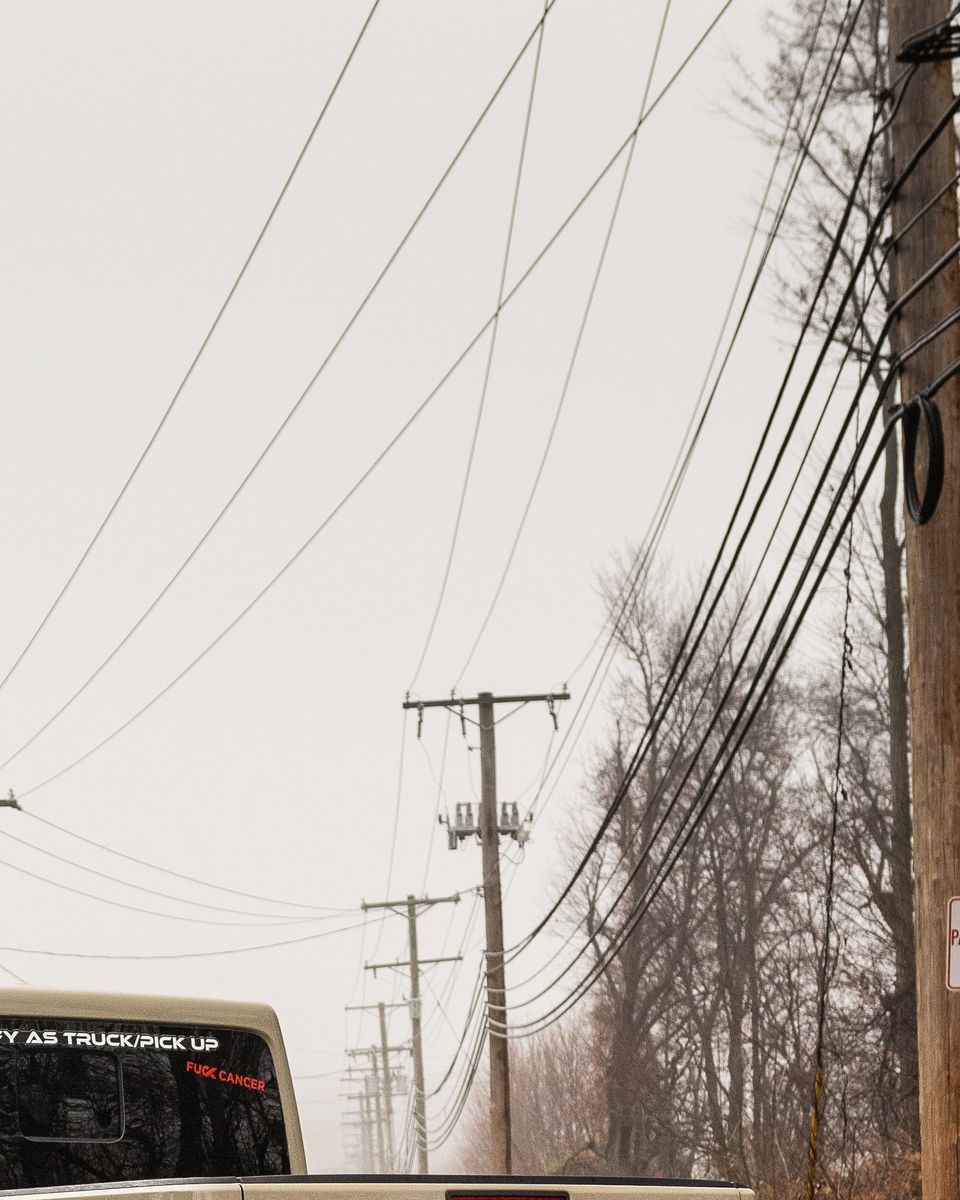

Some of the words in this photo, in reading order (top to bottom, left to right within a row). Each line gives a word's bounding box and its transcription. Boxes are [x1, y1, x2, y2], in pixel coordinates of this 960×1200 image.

[25, 1031, 58, 1045] AS
[62, 1032, 187, 1051] TRUCK/PICK
[190, 1037, 220, 1051] UP
[218, 1070, 266, 1092] CANCER
